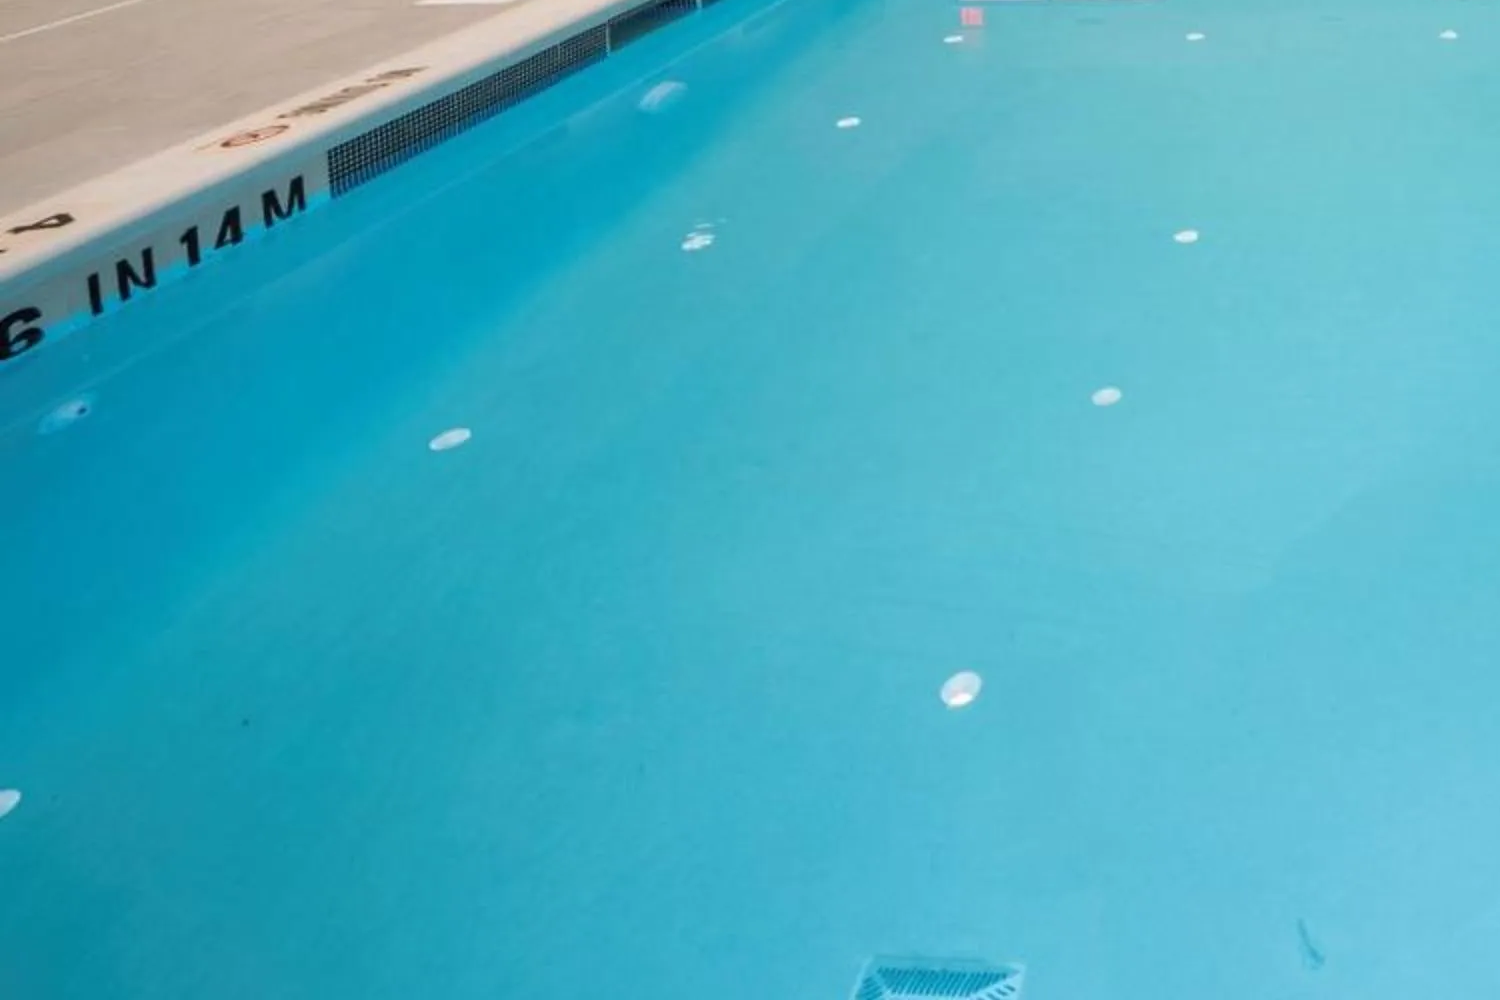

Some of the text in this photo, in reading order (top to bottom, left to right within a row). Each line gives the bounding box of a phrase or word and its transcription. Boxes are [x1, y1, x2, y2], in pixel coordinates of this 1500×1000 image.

[0, 306, 45, 361] 6
[87, 247, 156, 316] IN
[261, 176, 305, 227] M
